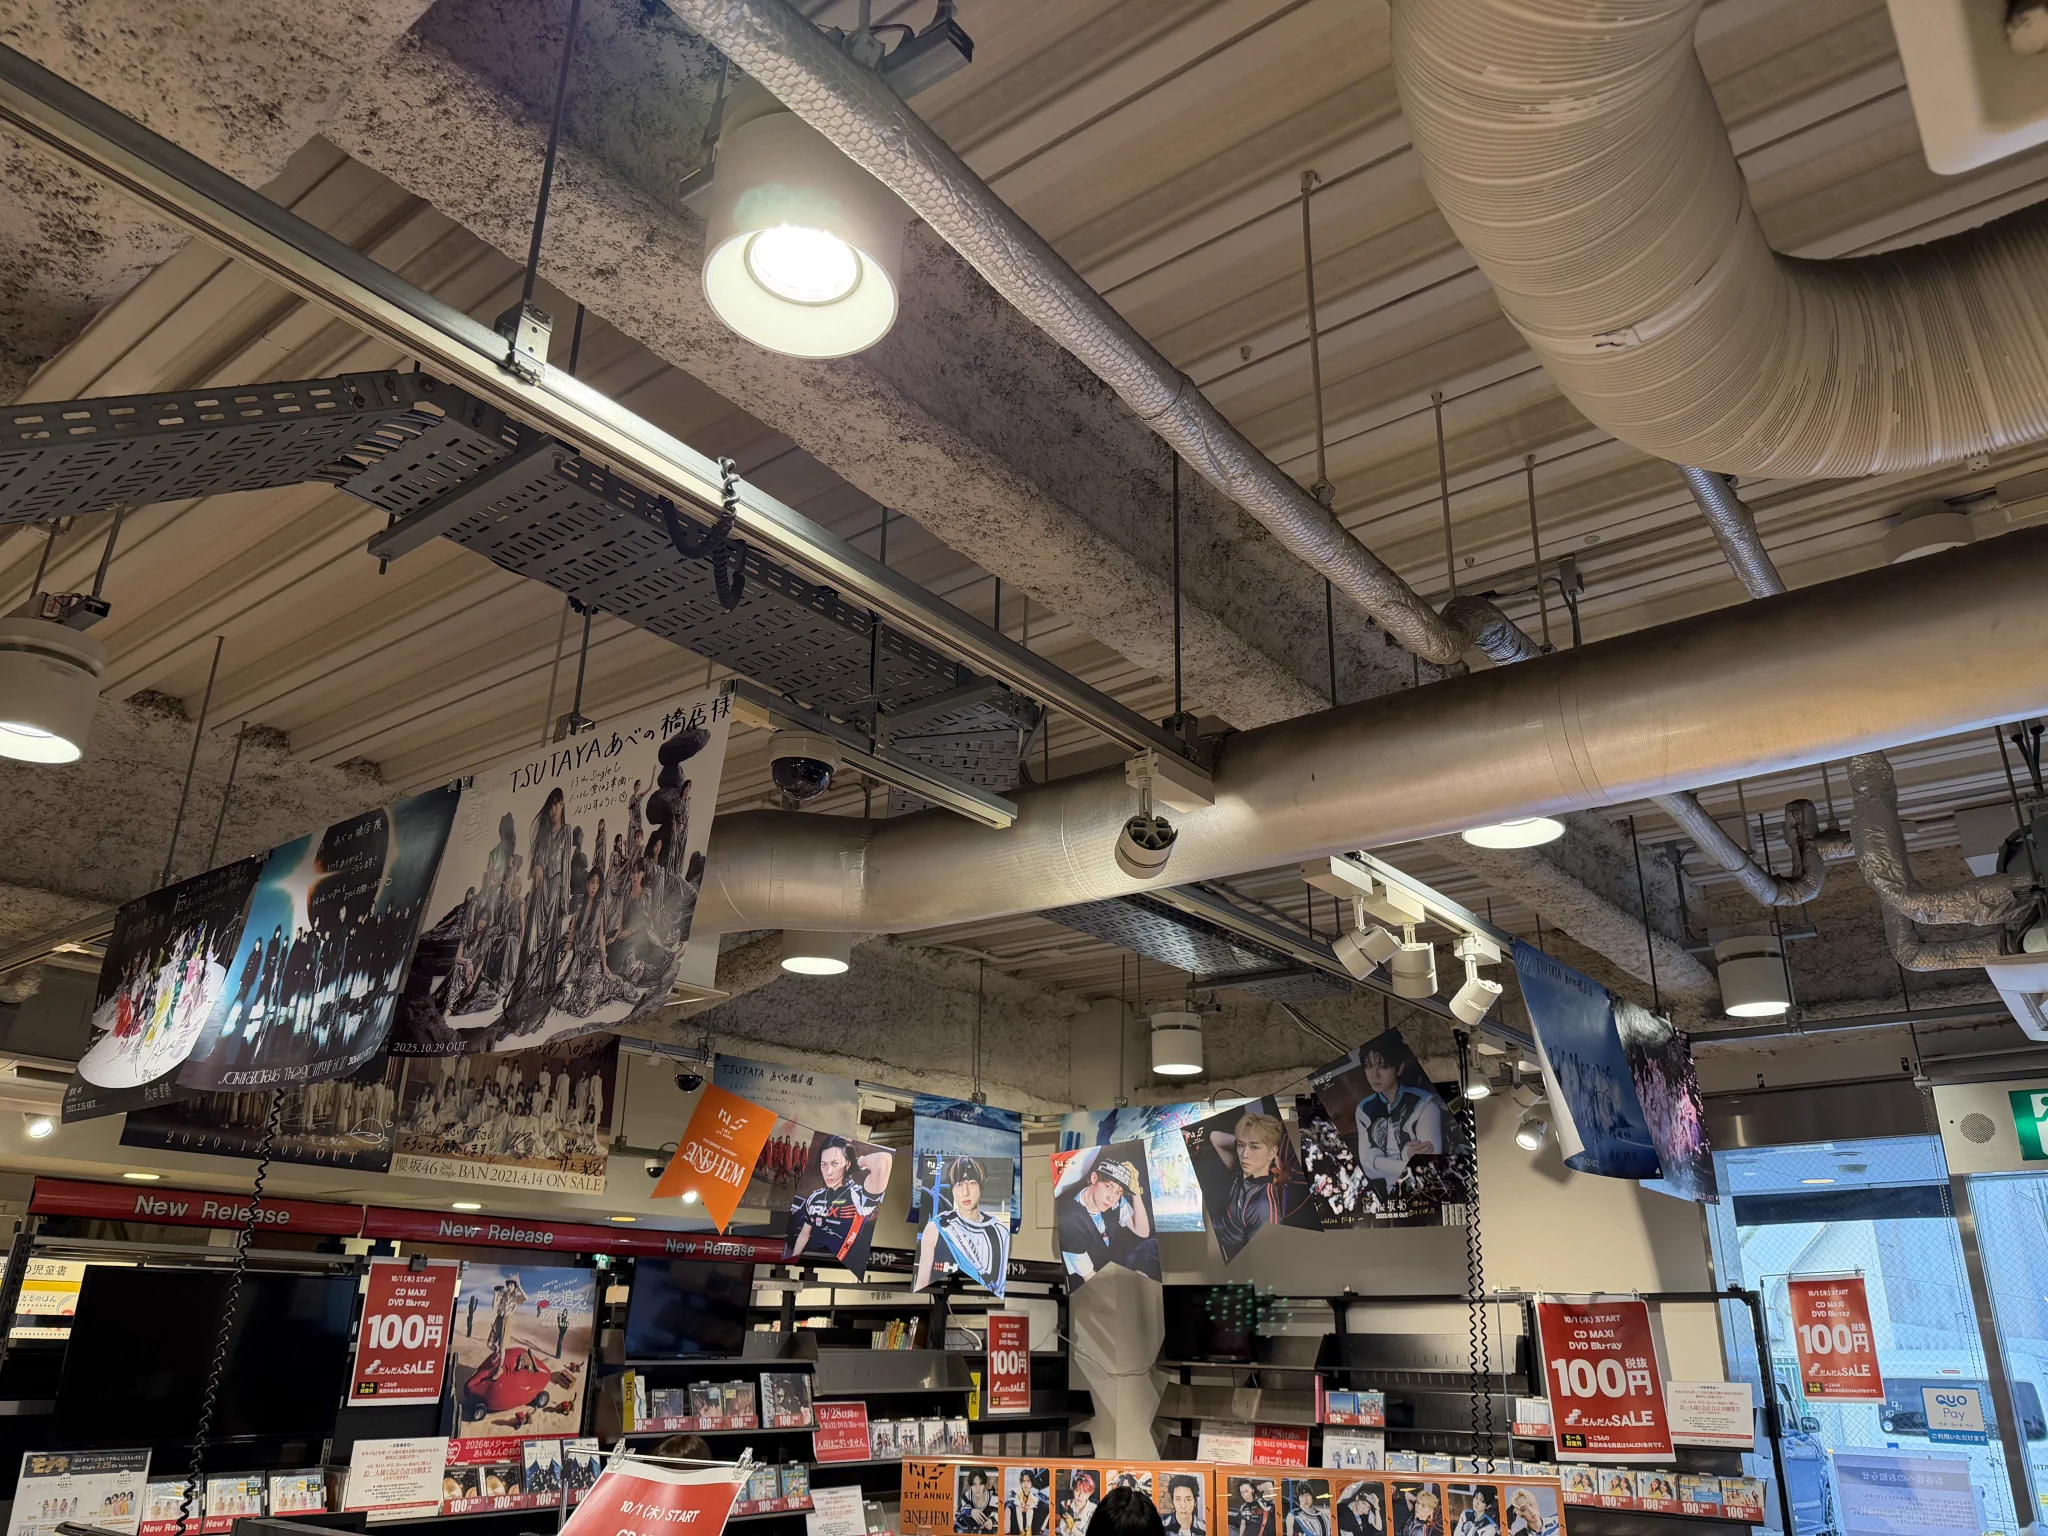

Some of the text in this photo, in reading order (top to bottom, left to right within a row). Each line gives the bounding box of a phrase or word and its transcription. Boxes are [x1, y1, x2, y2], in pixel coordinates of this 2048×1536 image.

[510, 738, 601, 793] TSUTAYA
[393, 1040, 468, 1053] 2025.10.29 OUT
[722, 1064, 764, 1078] TSUTAYA
[315, 1149, 358, 1164] OUT
[394, 1157, 438, 1175] 櫻坂46
[458, 1165, 490, 1181] BAN
[490, 1169, 544, 1186] 2021.4.14
[546, 1174, 568, 1189] ON
[569, 1176, 602, 1192] SALE
[134, 1195, 290, 1225] New Release
[438, 1219, 554, 1246] New Release
[665, 1238, 756, 1258] New Release
[1007, 1262, 1027, 1276] イドル
[416, 1276, 437, 1284] START
[395, 1288, 427, 1297] CD MAXI
[405, 1299, 431, 1308] Blu-ray
[1595, 1315, 1621, 1323] START
[1828, 1310, 1850, 1318] Blu-ray
[1573, 1329, 1614, 1338] CD MAXI
[1568, 1341, 1623, 1350] DVD Blu-ray
[1625, 1357, 1648, 1369] 税抜
[1936, 1395, 1967, 1407] QUO
[1581, 1410, 1655, 1427] だんだんSALE
[1943, 1408, 1966, 1421] Pay
[917, 1481, 938, 1490] INI
[904, 1492, 953, 1500] 5TH ANNIV.
[665, 1509, 700, 1523] START
[143, 1522, 199, 1533] New Relse
[205, 1518, 225, 1528] New
